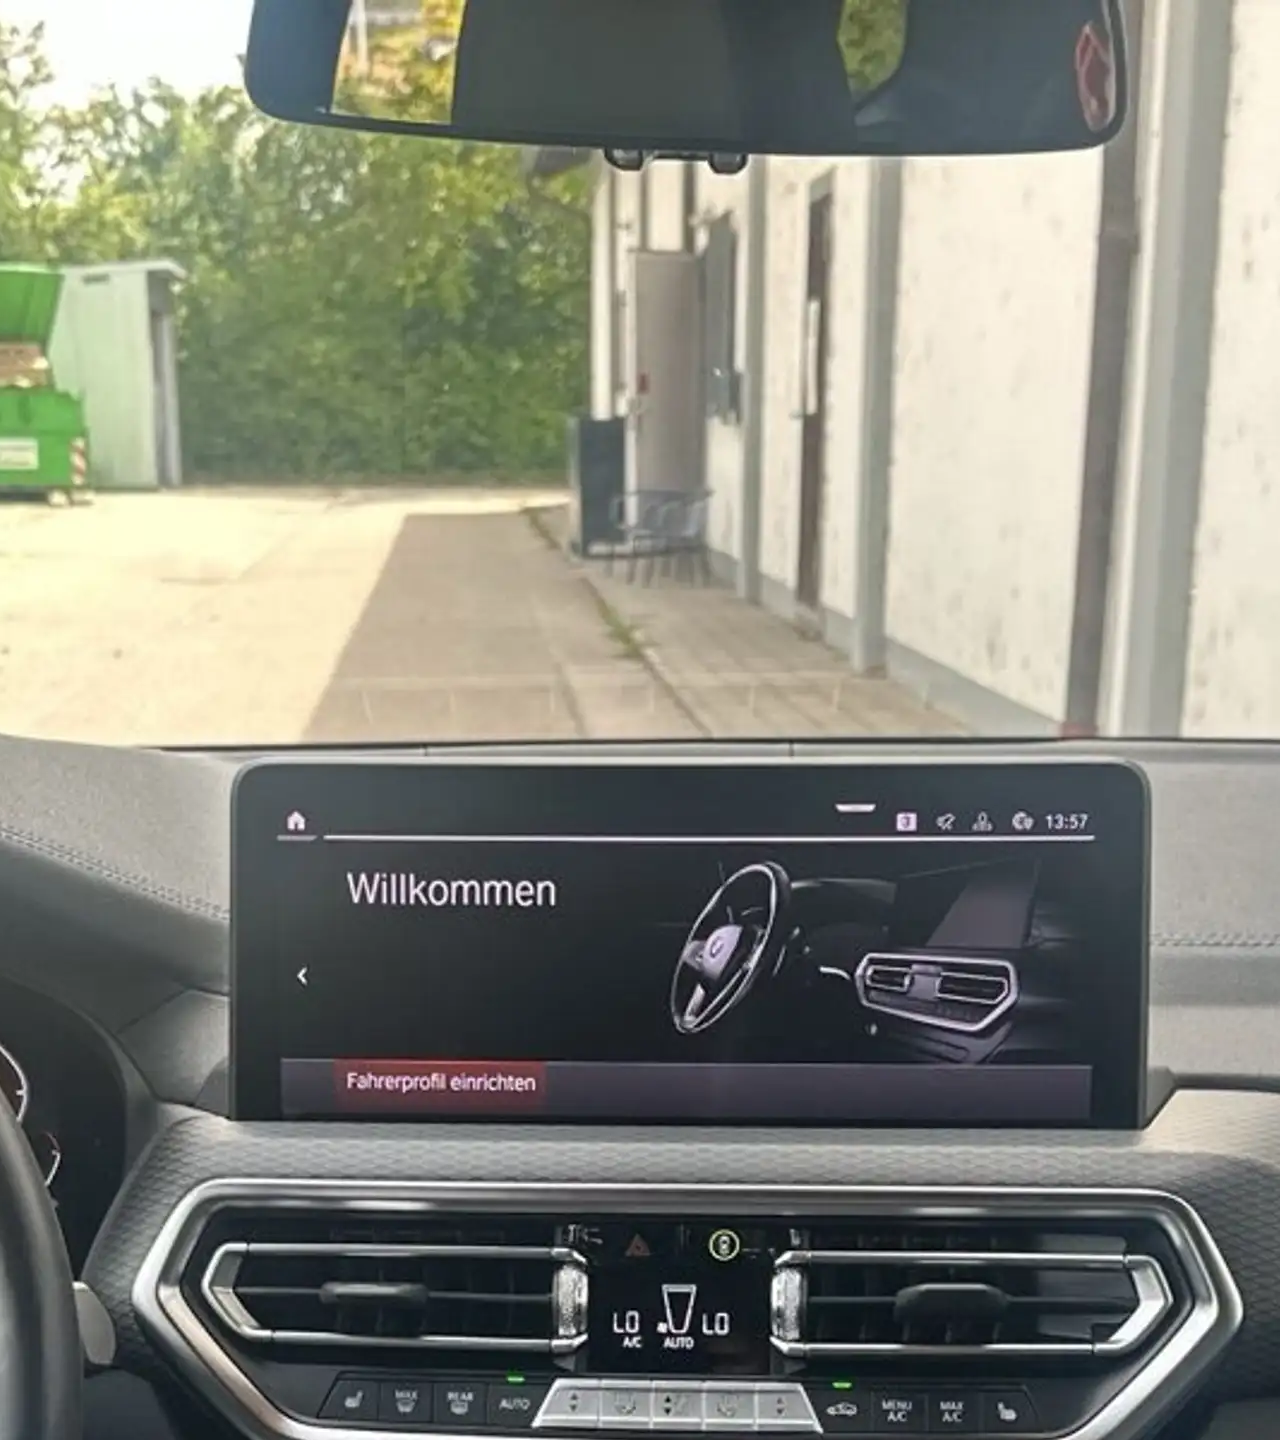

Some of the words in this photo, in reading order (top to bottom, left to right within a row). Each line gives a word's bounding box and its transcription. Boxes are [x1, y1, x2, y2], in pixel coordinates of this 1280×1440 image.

[1046, 813, 1088, 830] 13:57
[347, 871, 556, 906] Willkommen
[347, 1072, 446, 1093] Fahrerprofil
[450, 1073, 536, 1091] einrichten
[613, 1310, 640, 1334] LO
[702, 1312, 730, 1335] LO
[623, 1336, 642, 1348] A/C
[663, 1336, 695, 1349] AUTO
[499, 1398, 531, 1410] AUTO
[882, 1399, 912, 1411] MENU
[940, 1401, 964, 1411] MAX
[887, 1412, 908, 1422] A/C
[942, 1412, 963, 1422] A/C
